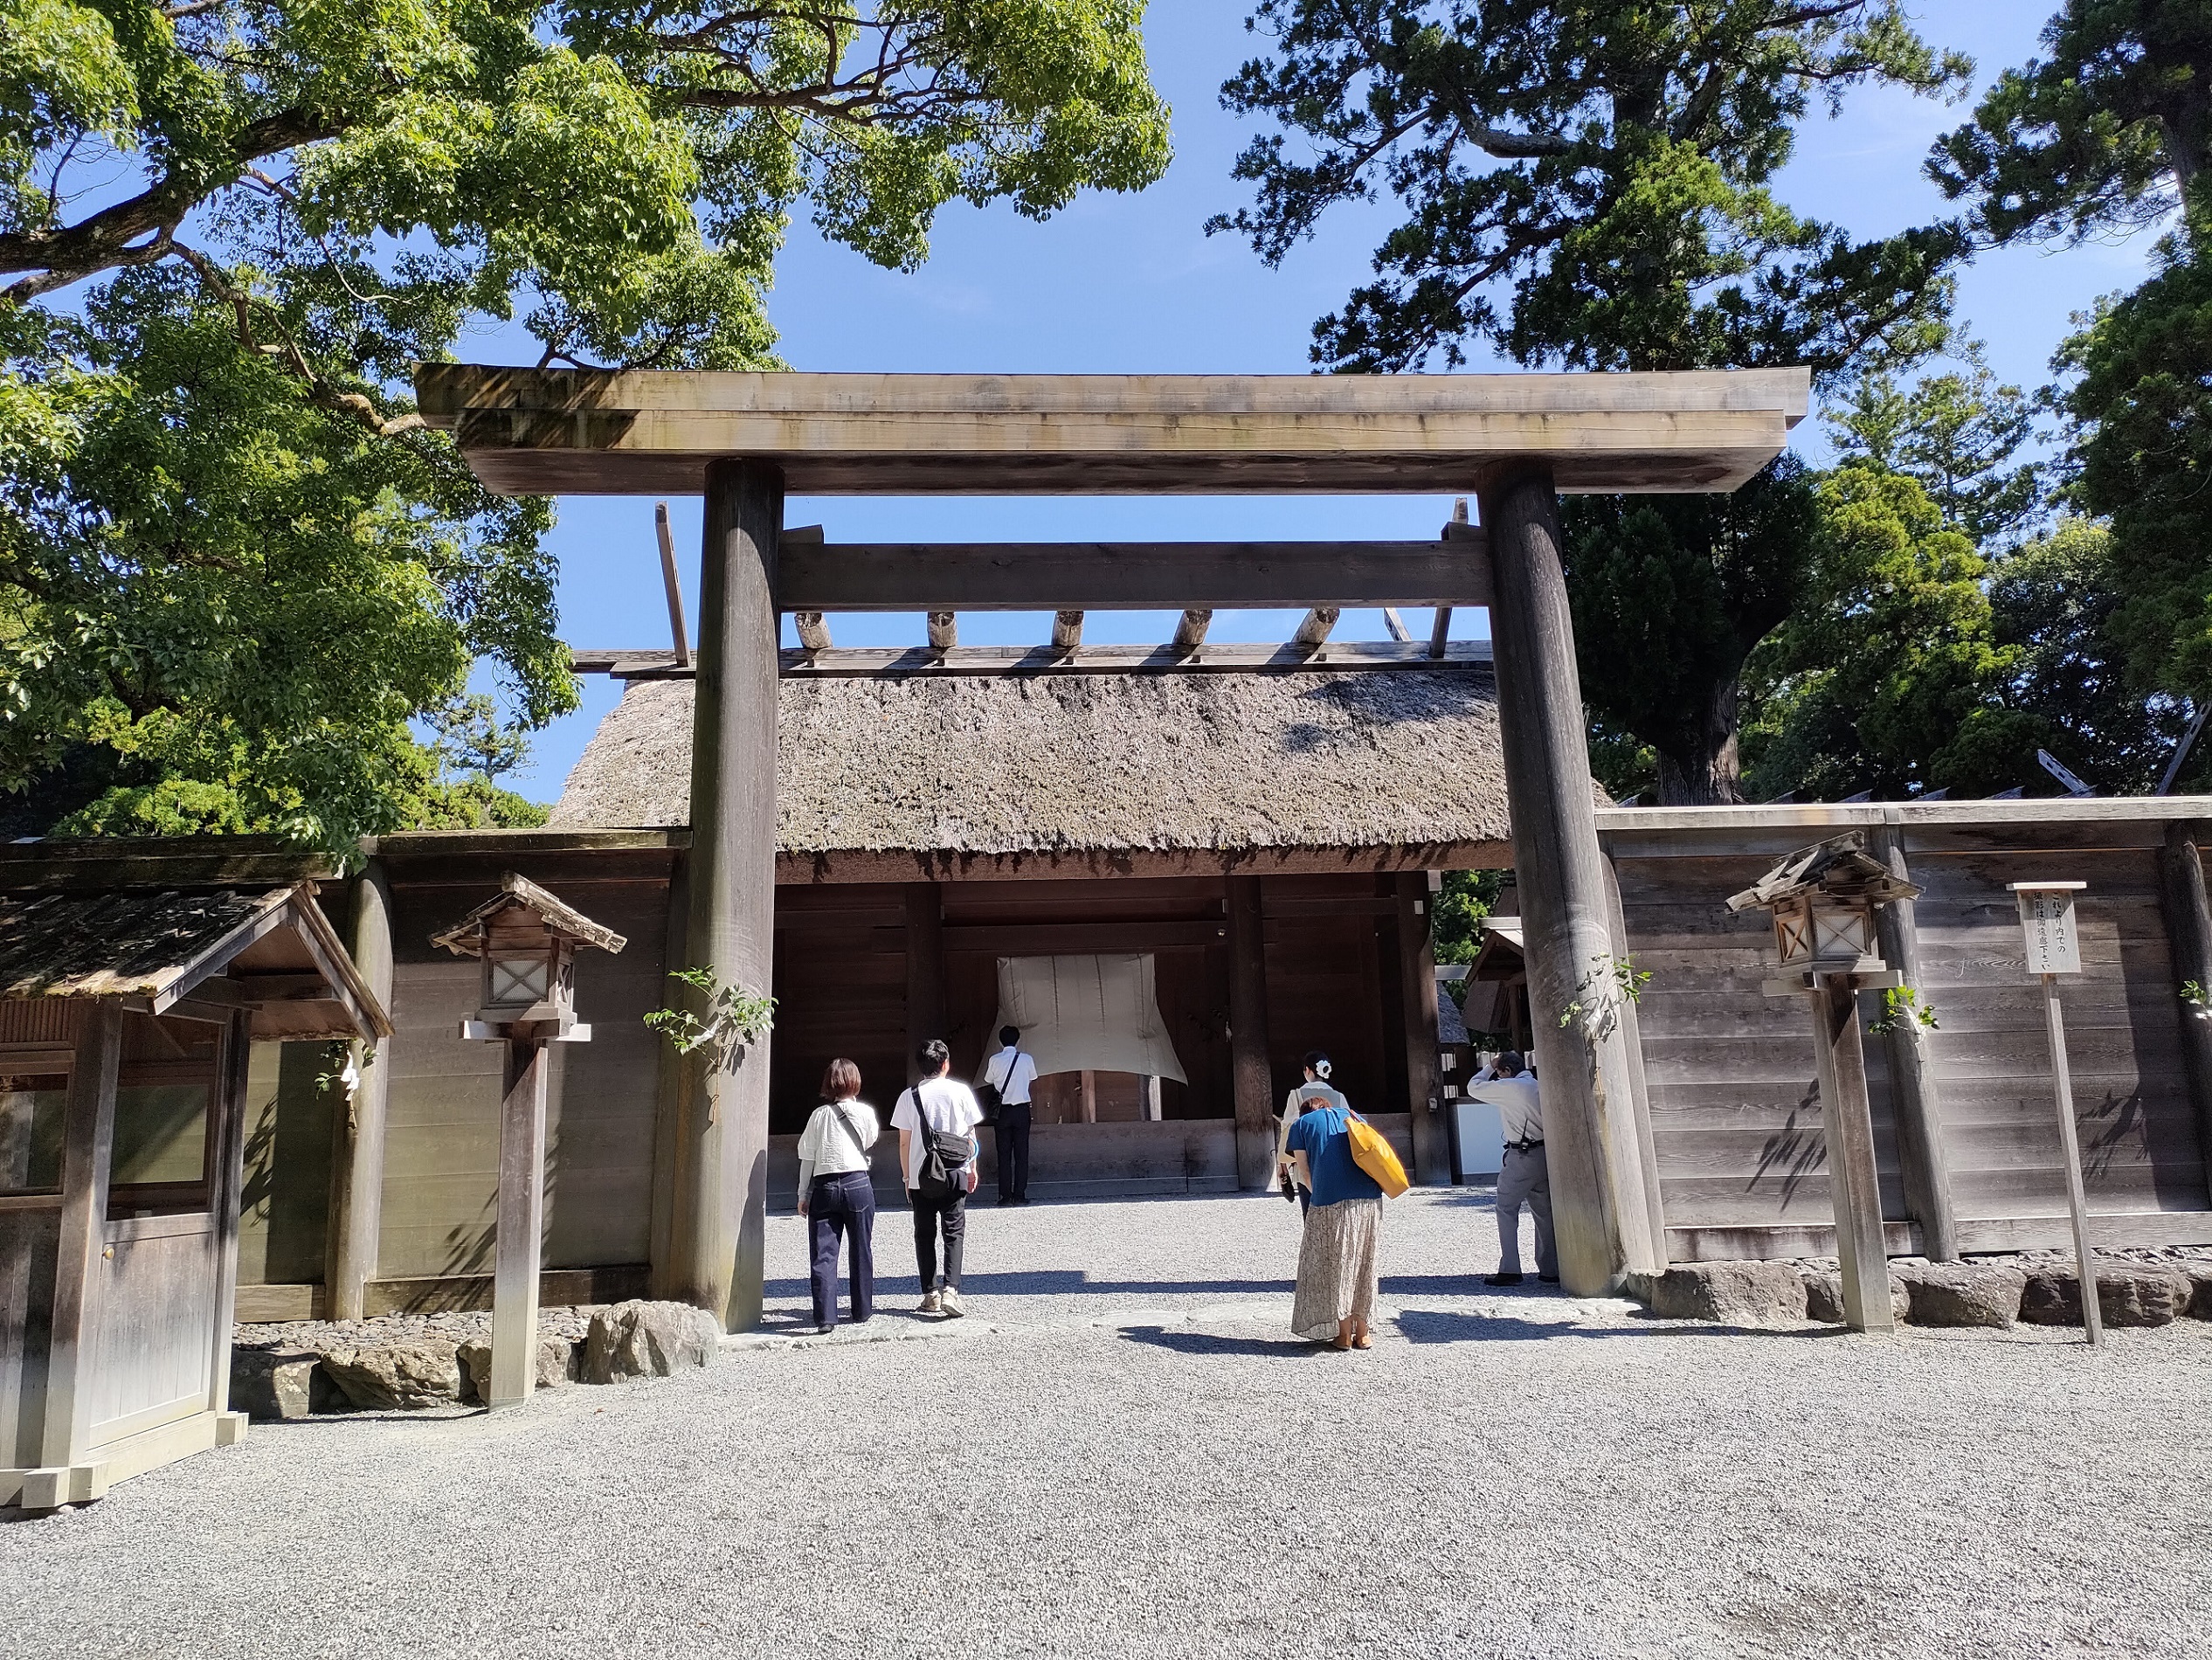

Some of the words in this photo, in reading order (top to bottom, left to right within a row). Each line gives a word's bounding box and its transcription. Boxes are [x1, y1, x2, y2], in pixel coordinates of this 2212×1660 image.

[2052, 892, 2066, 953] これより内での
